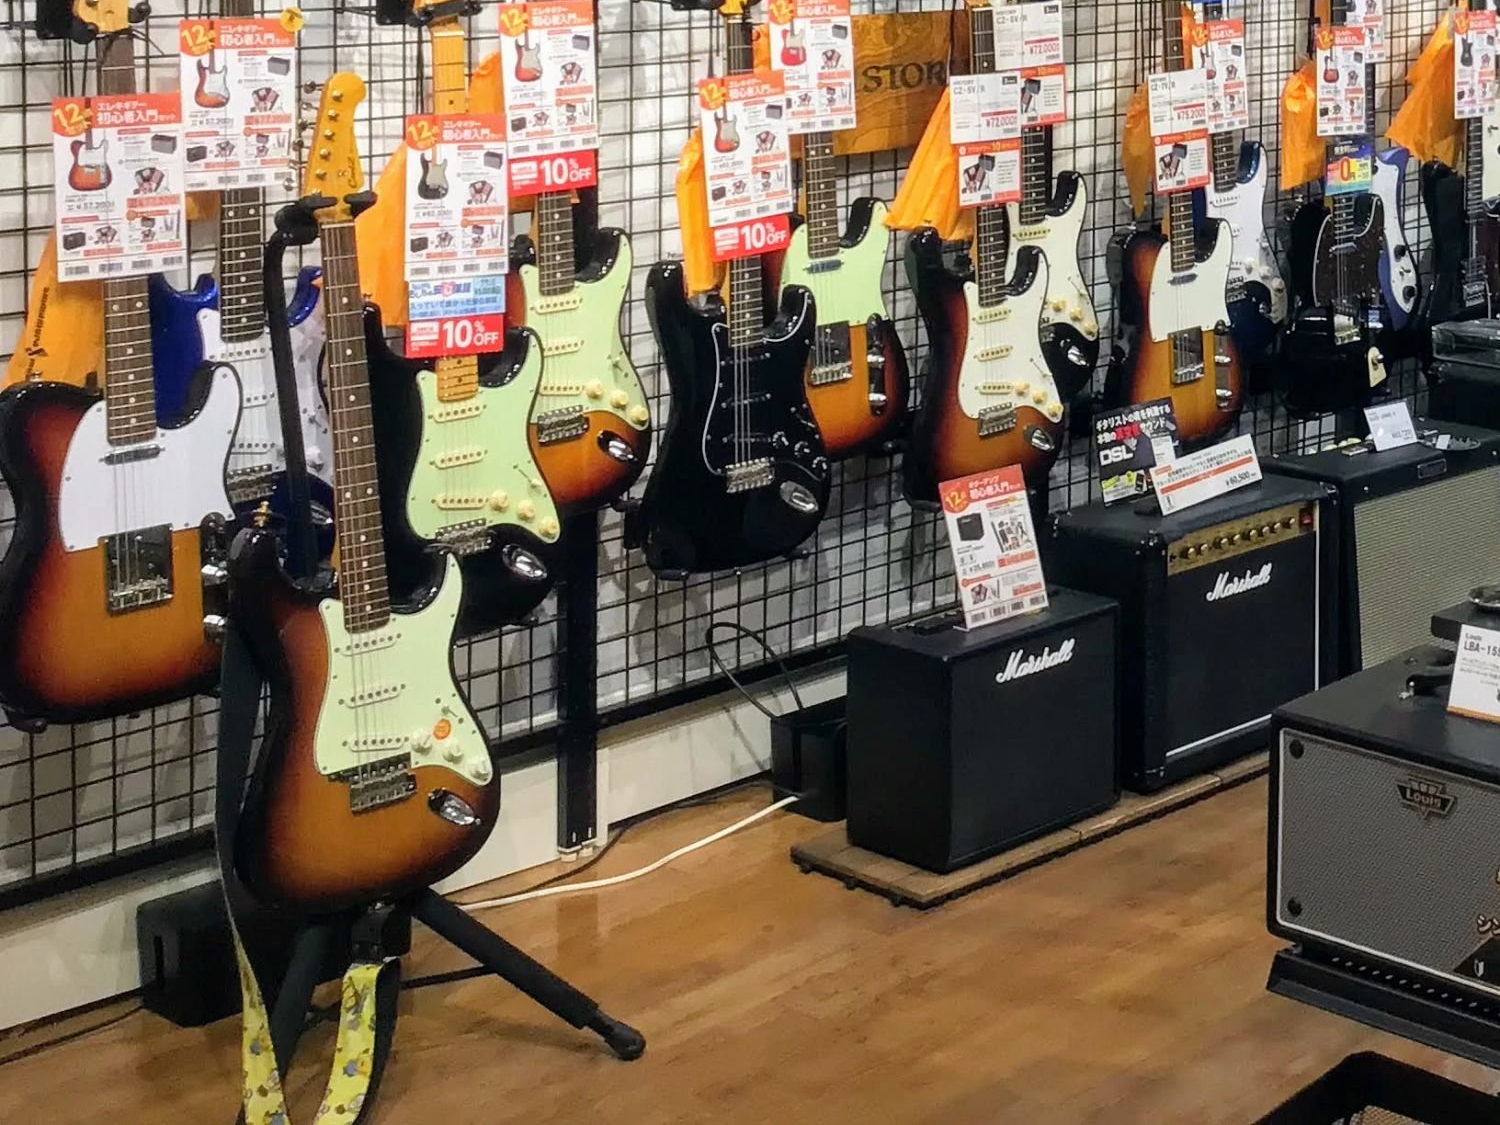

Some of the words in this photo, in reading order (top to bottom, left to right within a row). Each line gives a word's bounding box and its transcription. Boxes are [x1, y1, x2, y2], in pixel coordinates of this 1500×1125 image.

[540, 157, 568, 187] 10
[569, 167, 592, 182] OFF
[740, 222, 766, 251] 10
[766, 229, 787, 246] OFF
[442, 319, 473, 349] 10
[473, 331, 499, 347] OFF
[1100, 444, 1134, 467] DSL
[1206, 562, 1273, 602] Marshall
[995, 638, 1076, 684] Marshall
[1405, 787, 1442, 808] Louis
